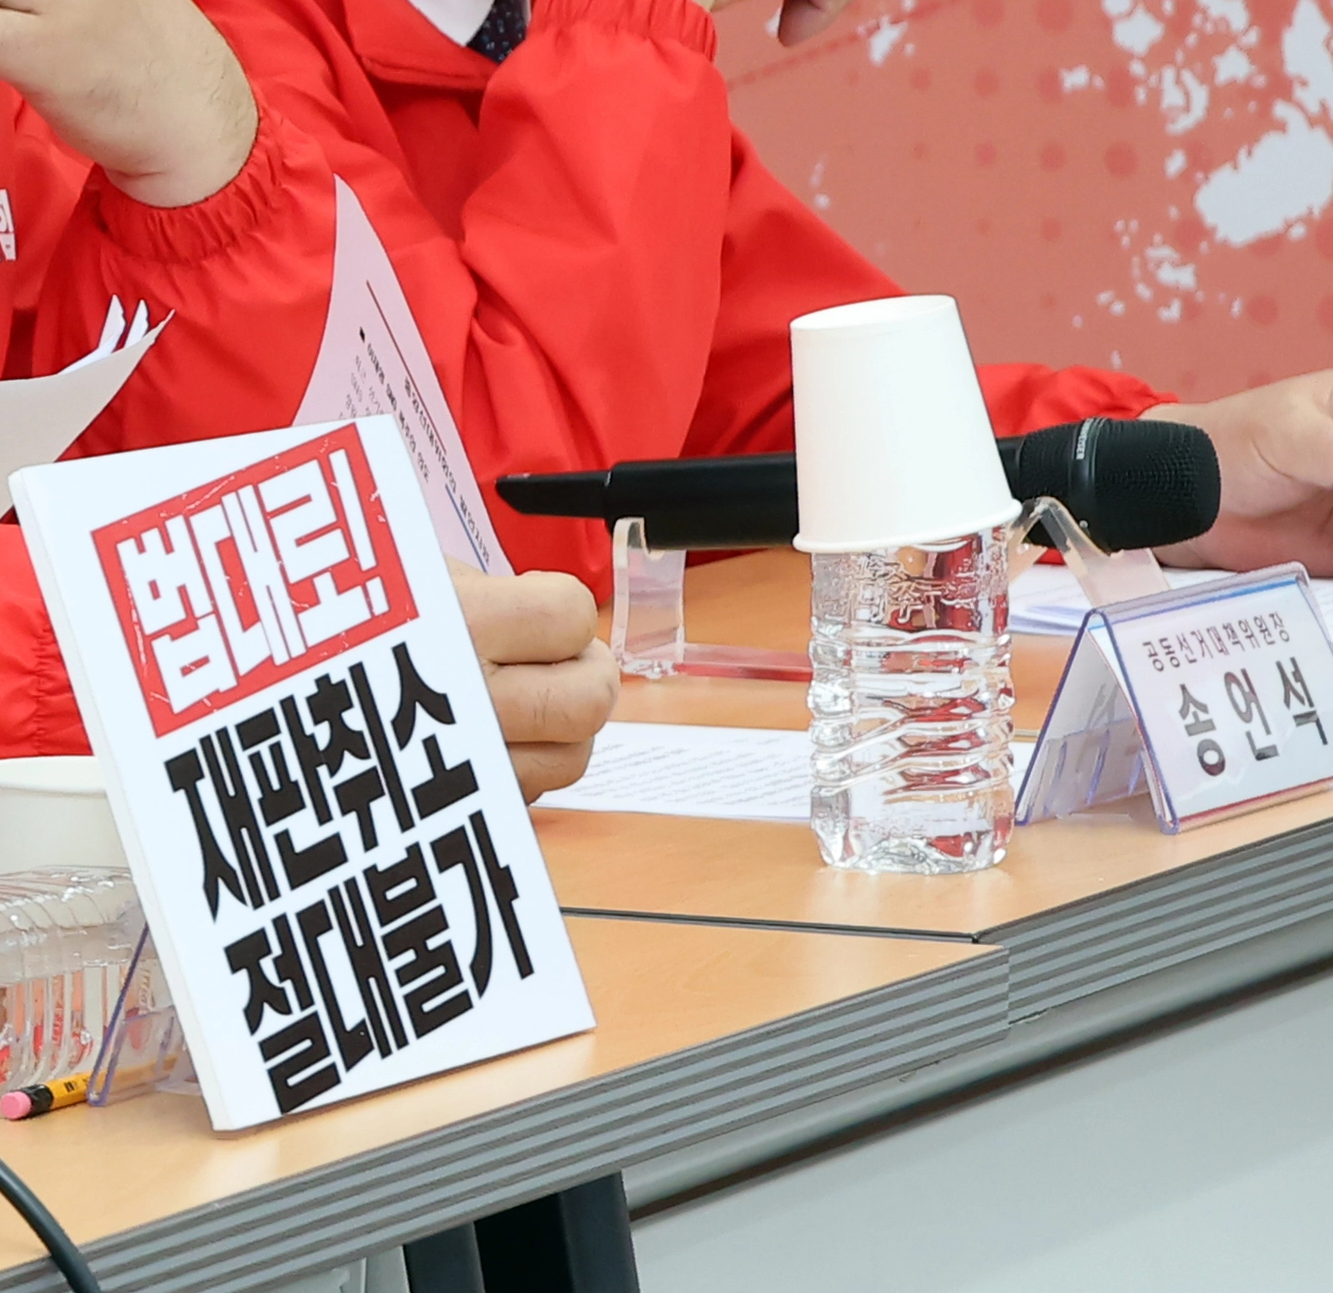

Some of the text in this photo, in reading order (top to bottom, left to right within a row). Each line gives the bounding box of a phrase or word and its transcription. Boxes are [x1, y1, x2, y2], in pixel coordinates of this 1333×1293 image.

[116, 449, 389, 715] 법대로!
[1142, 611, 1291, 672] 공동선거대책위원장
[164, 641, 479, 924] 재판취소
[1179, 656, 1328, 776] 송언석
[224, 810, 534, 1115] 절대불가
